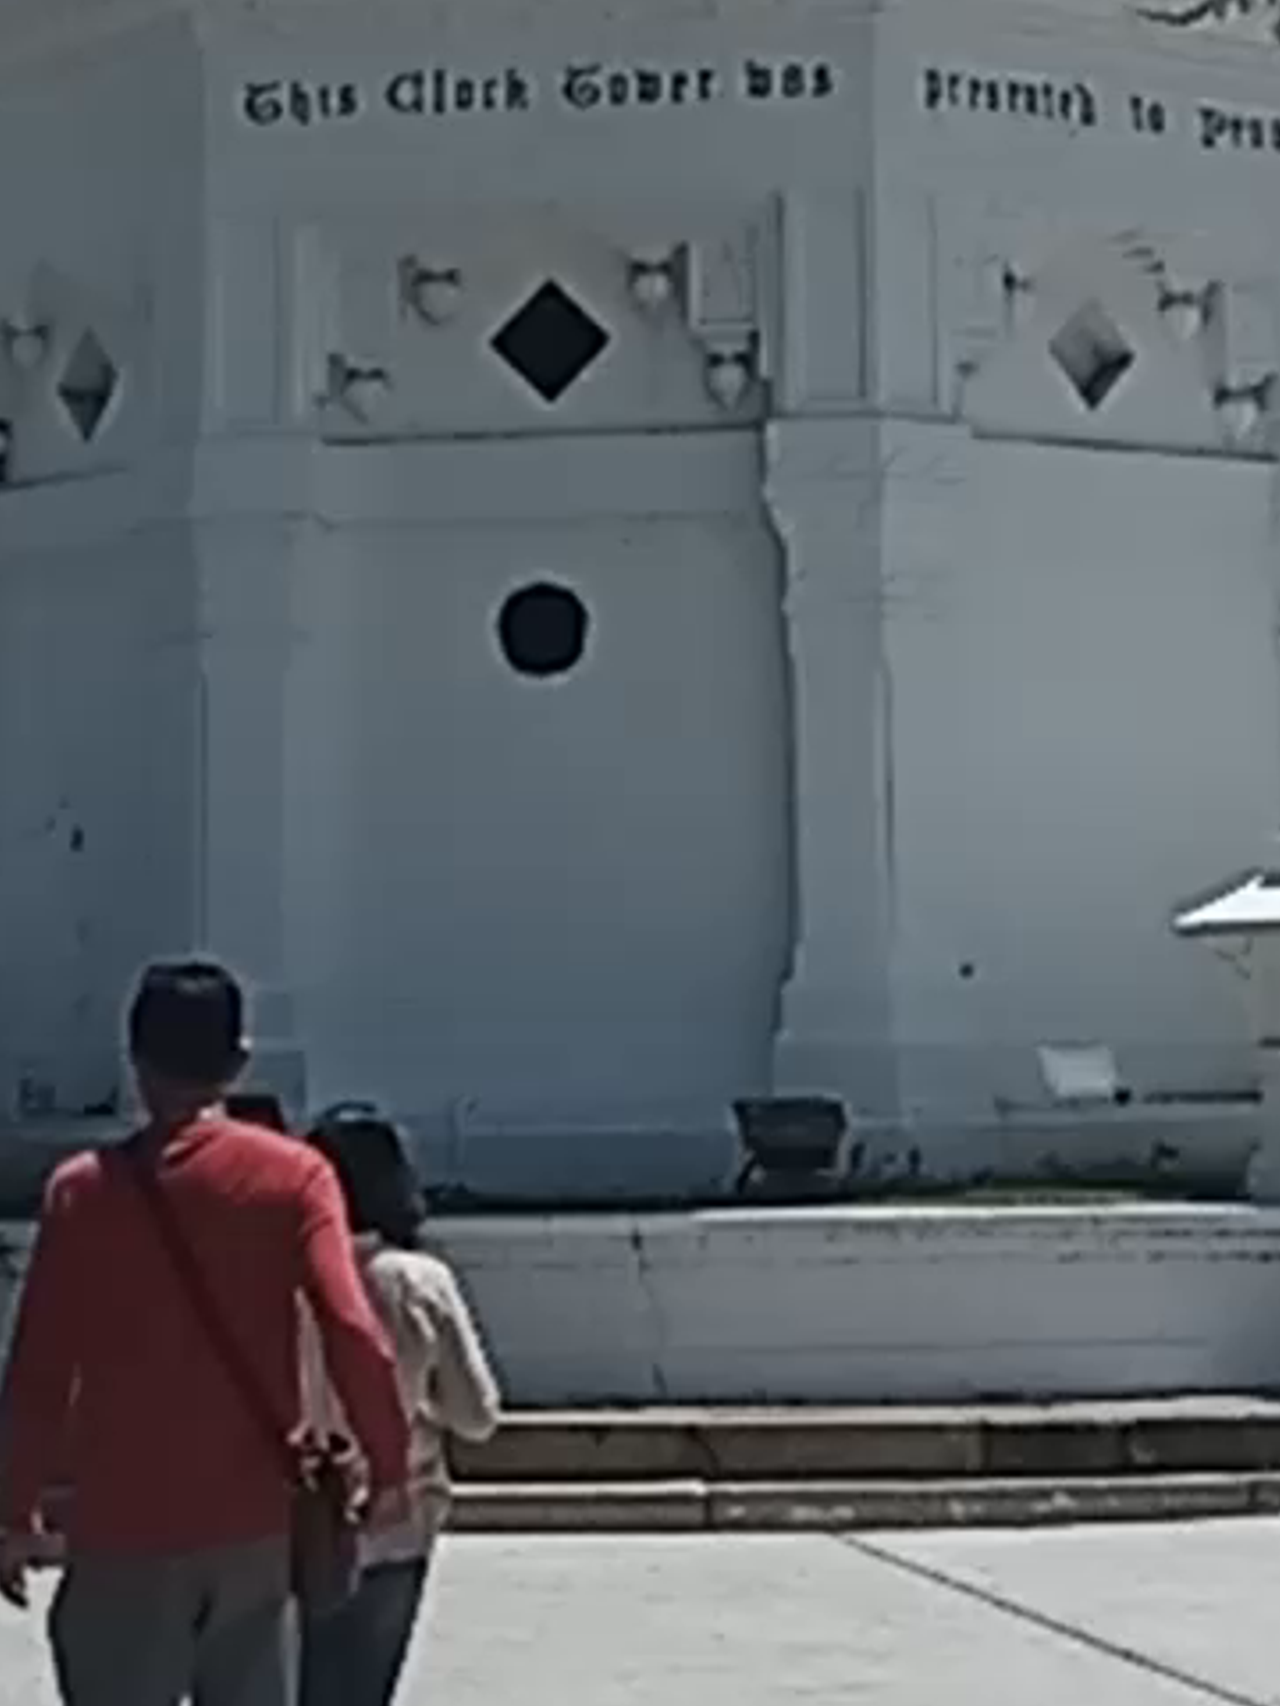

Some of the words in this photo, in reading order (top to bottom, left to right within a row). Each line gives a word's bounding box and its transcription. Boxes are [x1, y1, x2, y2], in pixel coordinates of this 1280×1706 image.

[243, 82, 358, 126] This
[384, 68, 529, 115] Clock
[562, 64, 715, 110] Tower
[1130, 95, 1166, 133] to
